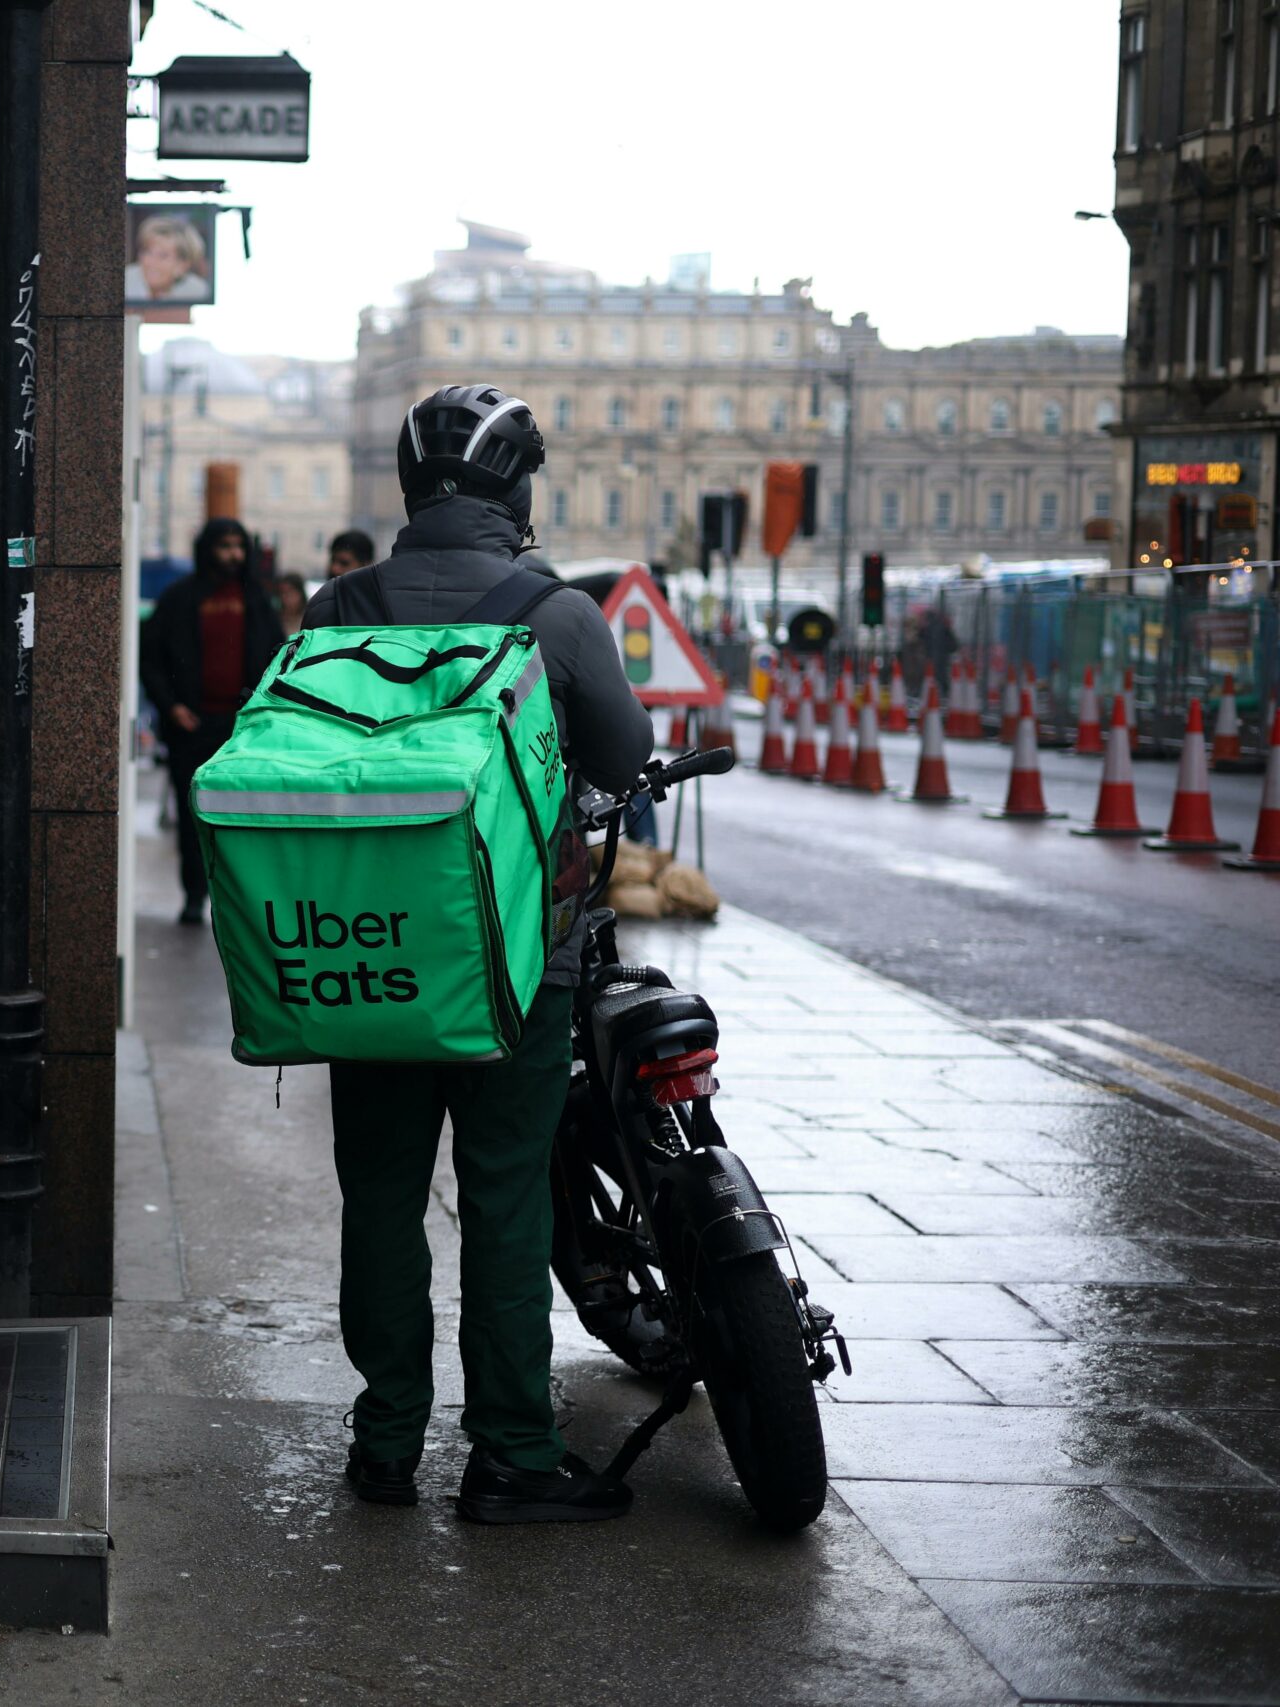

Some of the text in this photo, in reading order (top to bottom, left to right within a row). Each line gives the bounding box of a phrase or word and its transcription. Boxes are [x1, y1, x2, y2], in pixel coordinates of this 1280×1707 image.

[169, 104, 306, 137] ARCADE
[528, 721, 556, 766] Ube
[264, 900, 409, 949] Uber
[274, 959, 419, 1007] Eats
